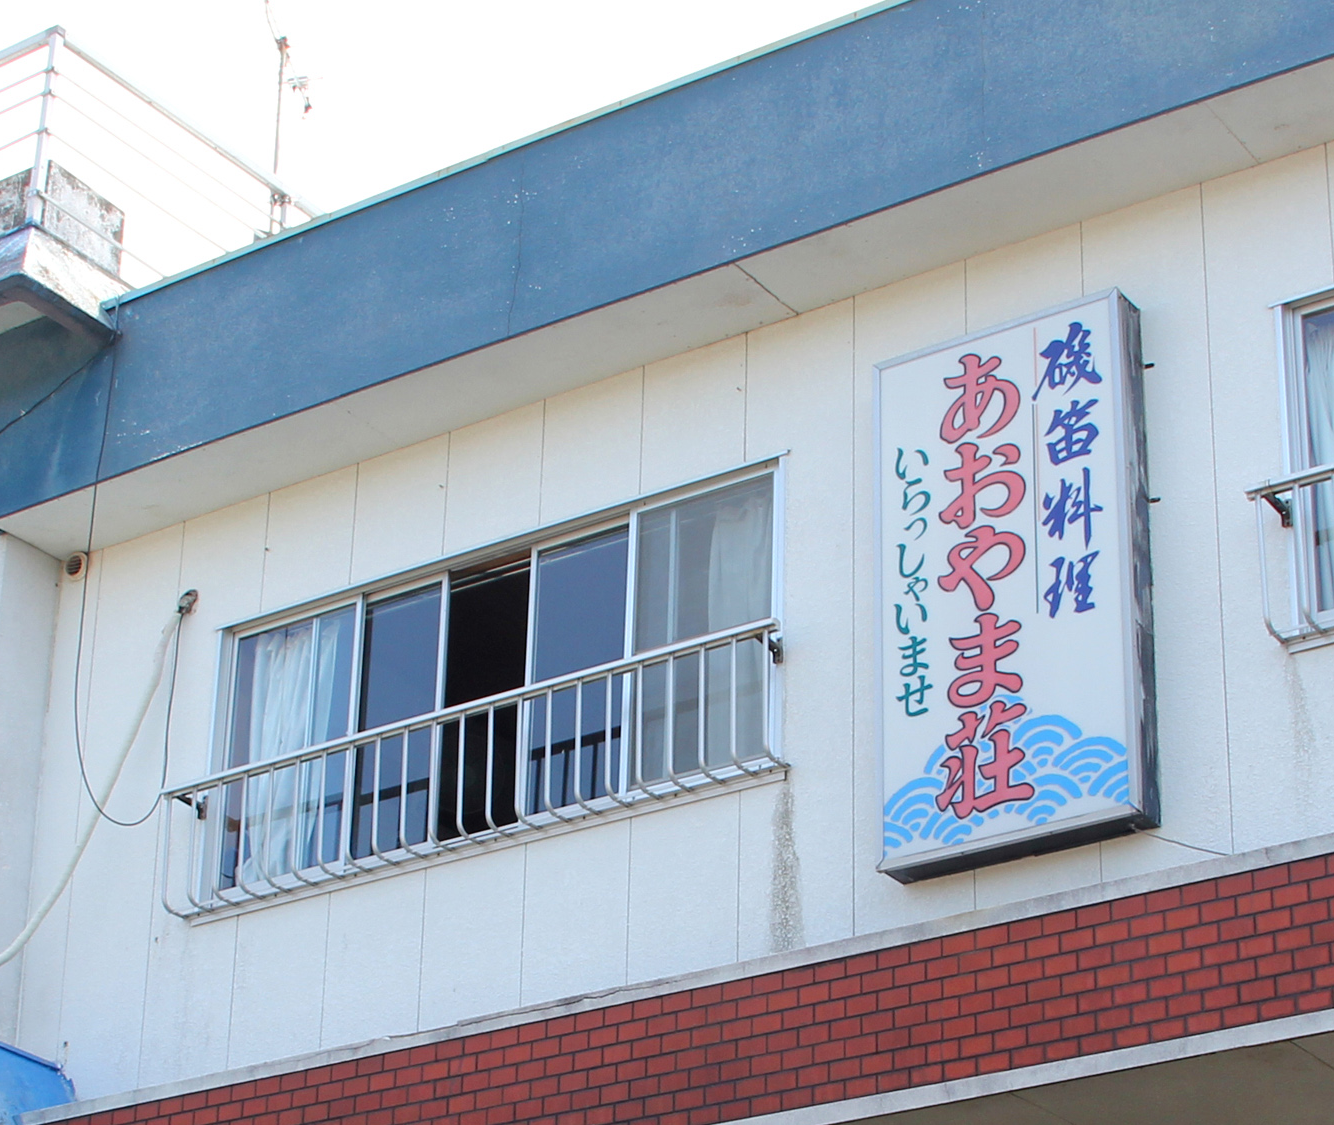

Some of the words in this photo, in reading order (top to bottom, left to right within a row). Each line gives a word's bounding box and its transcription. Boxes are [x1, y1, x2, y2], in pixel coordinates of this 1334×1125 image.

[893, 446, 934, 717] いらっしゃいませ
[936, 353, 1035, 819] あおやま荘
[1032, 321, 1104, 619] 磯笛料理
